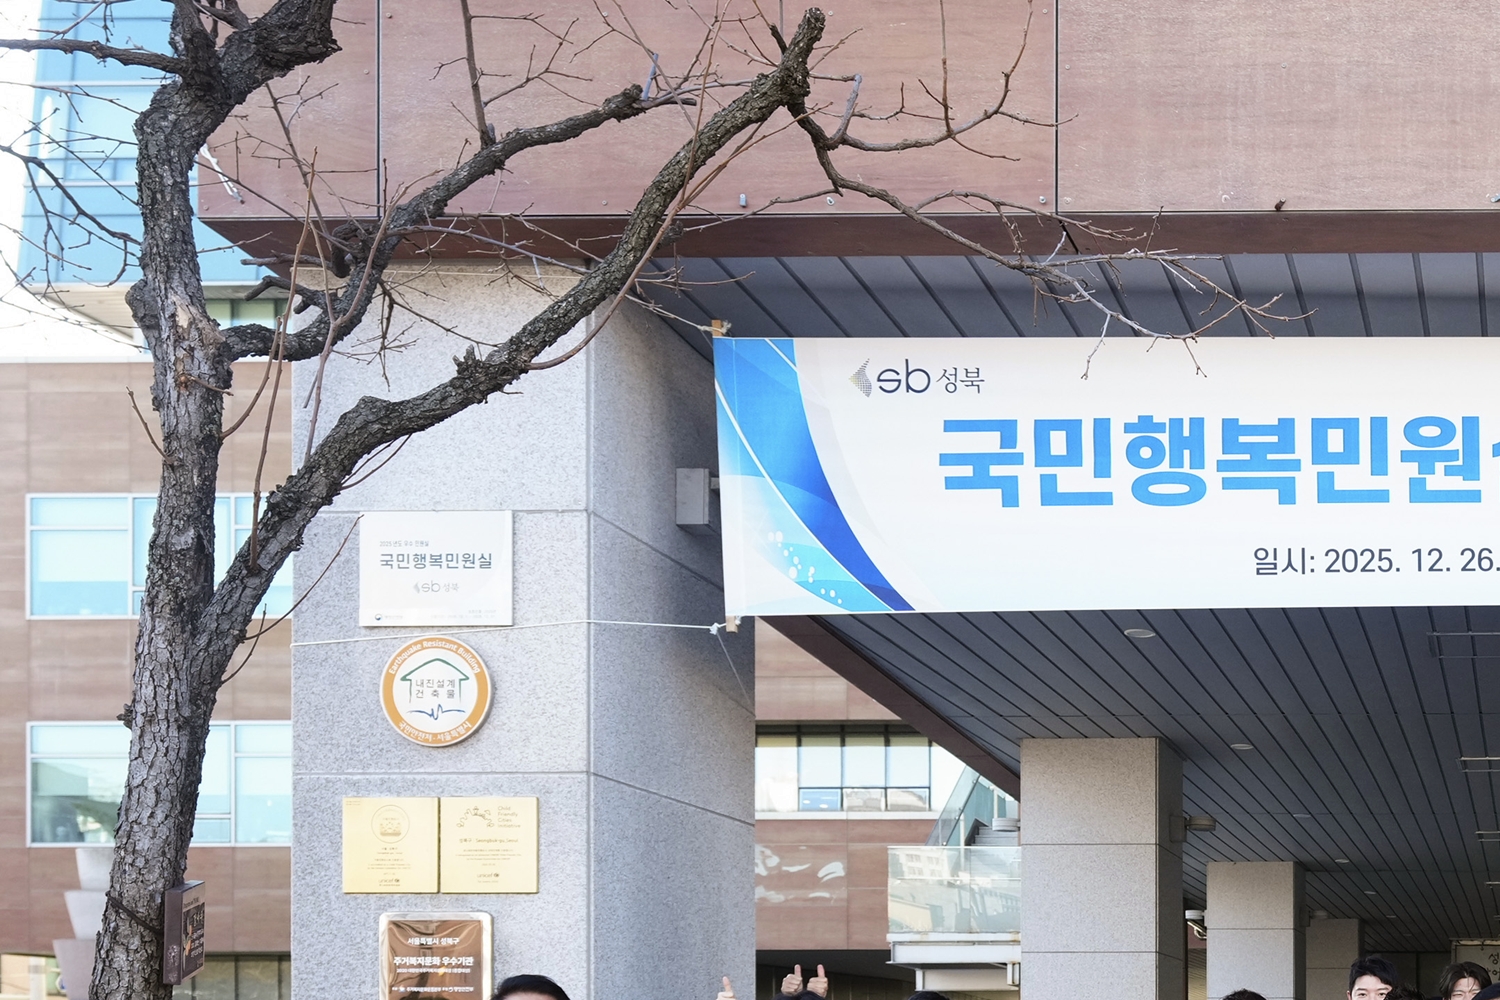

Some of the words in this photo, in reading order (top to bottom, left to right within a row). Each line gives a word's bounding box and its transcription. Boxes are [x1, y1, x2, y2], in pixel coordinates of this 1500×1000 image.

[877, 359, 931, 394] sb
[937, 366, 985, 394] 성북
[380, 553, 492, 569] 국민행복민원실
[1254, 548, 1314, 575] 일시:
[1325, 549, 1400, 573] 2025.
[1412, 548, 1450, 572] 12.
[421, 580, 441, 592] sb
[443, 583, 460, 592] 성북
[389, 644, 422, 674] Earthquake
[423, 640, 457, 651] Resistant
[458, 648, 481, 674] Building
[416, 679, 455, 688] 내진설계
[394, 957, 440, 966] 주거복지문화
[442, 957, 474, 966] 우수기관
